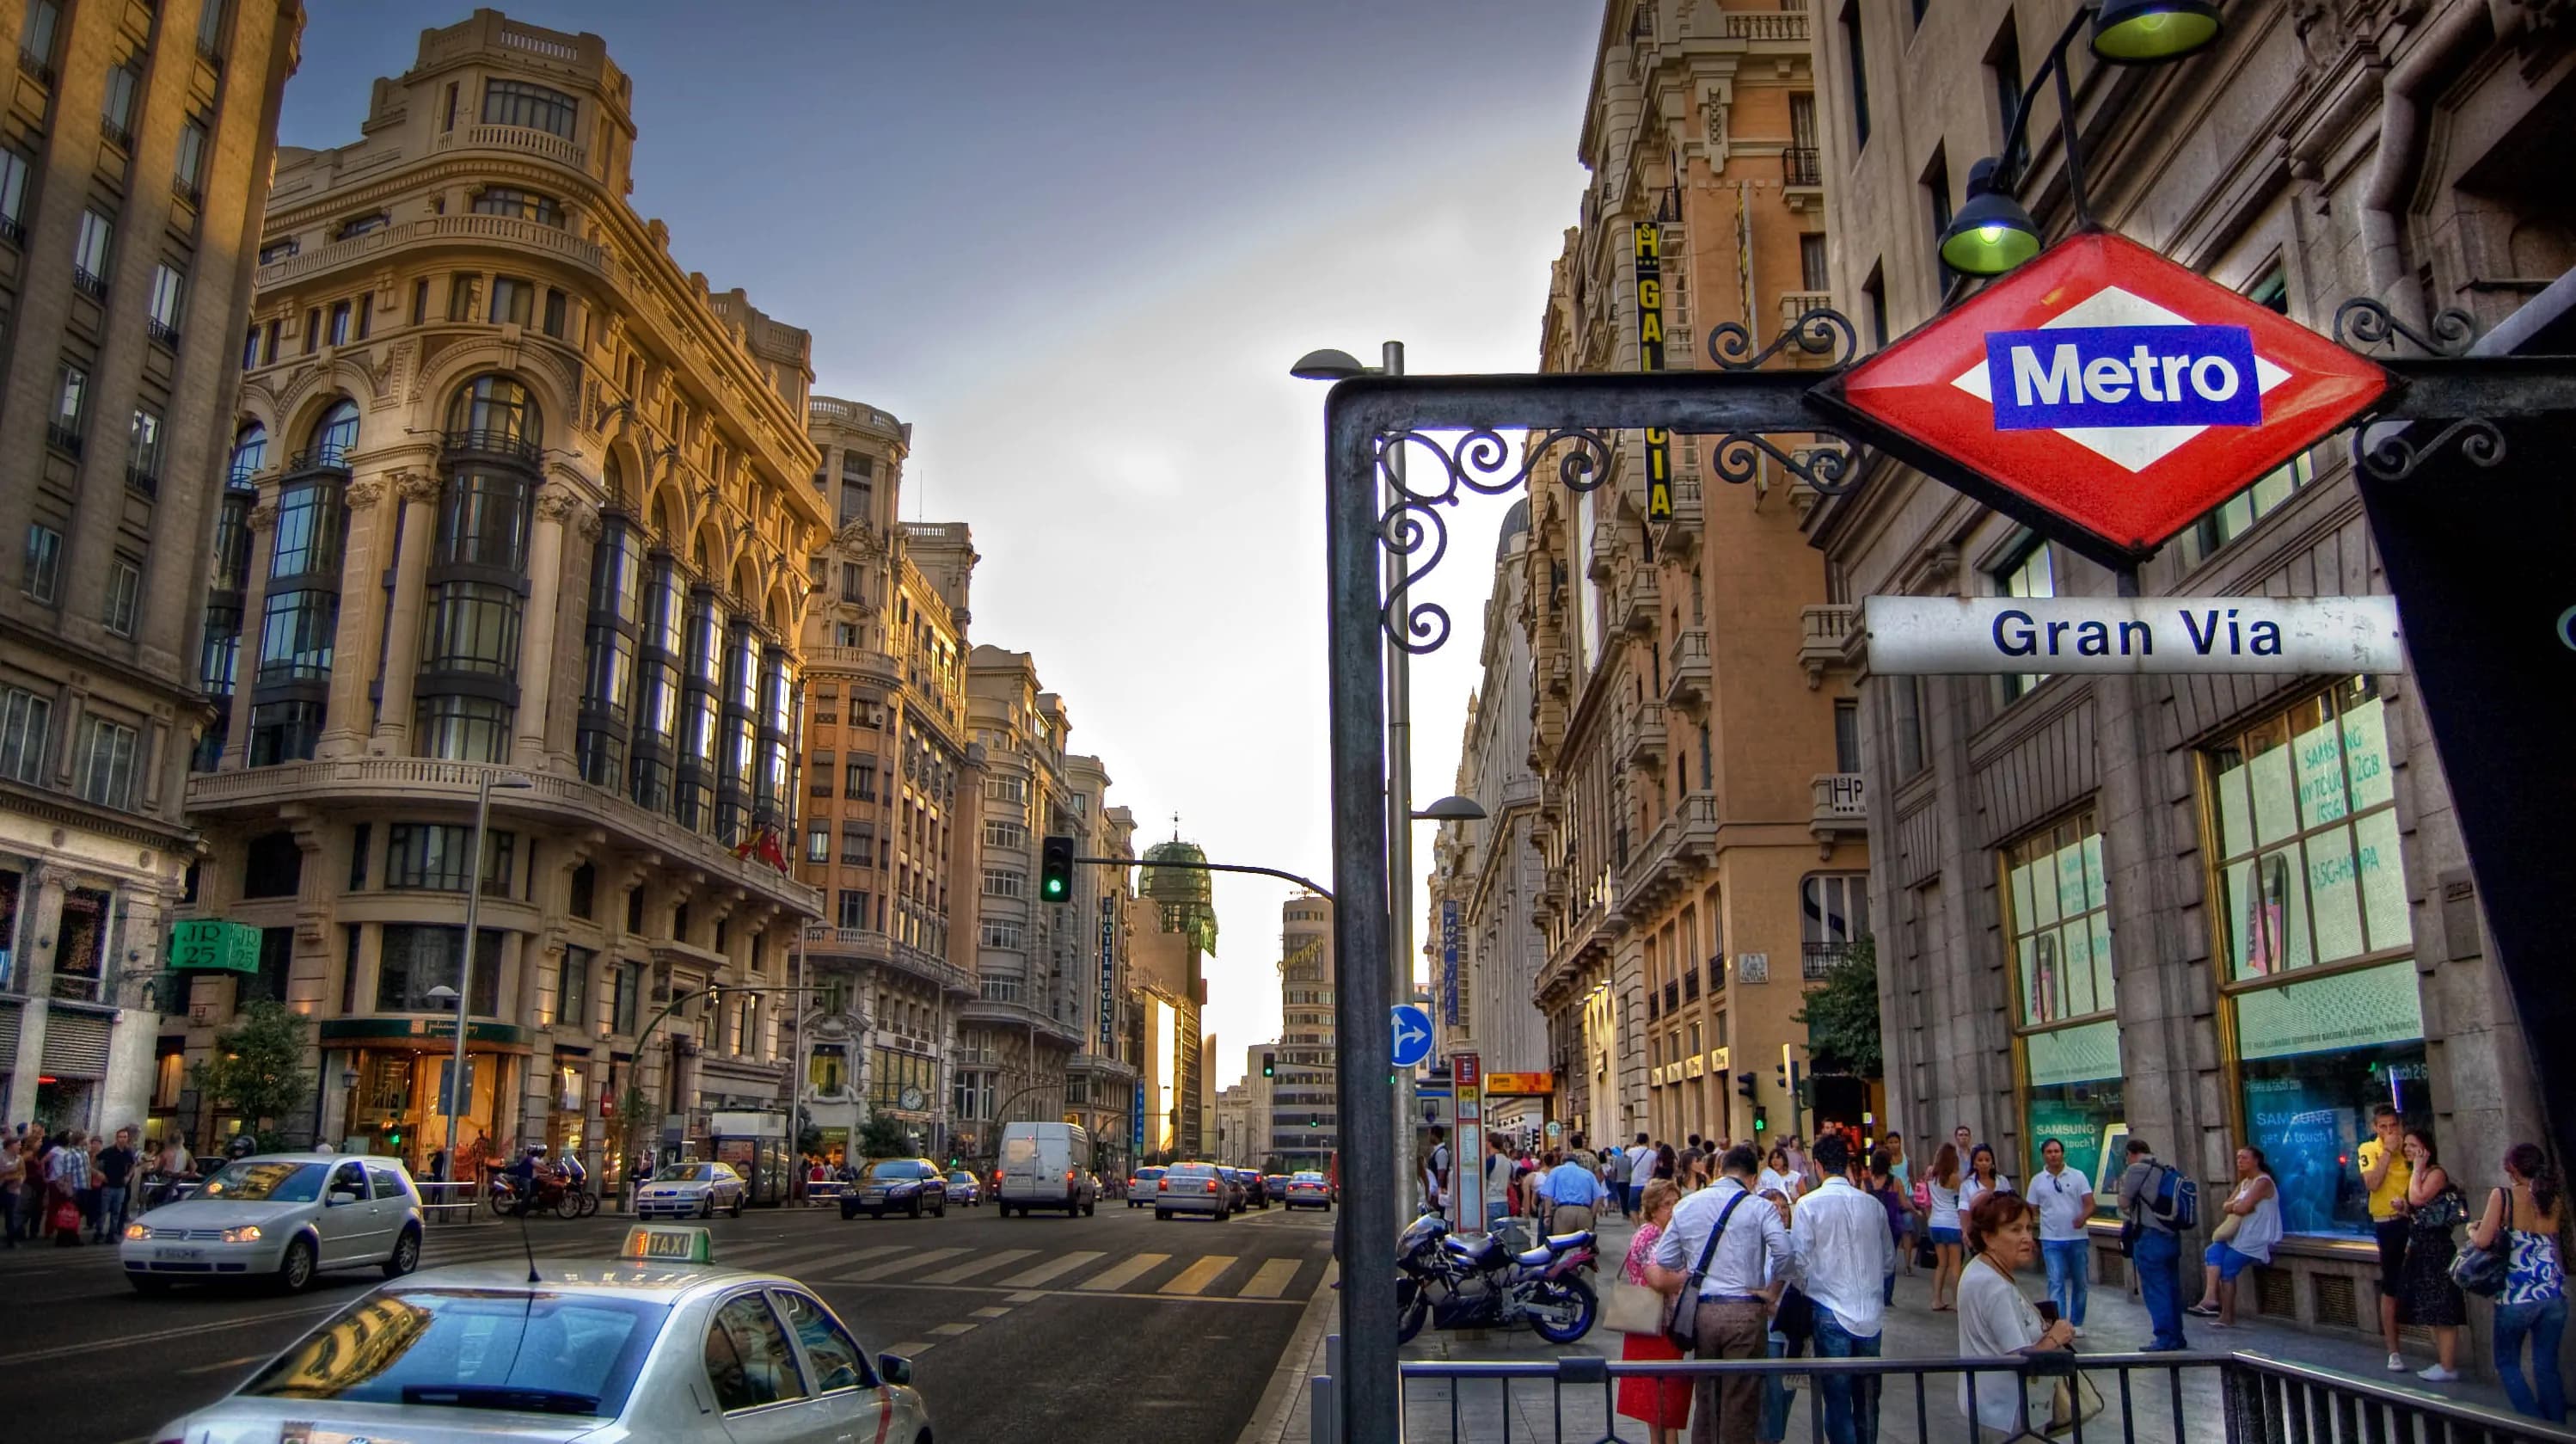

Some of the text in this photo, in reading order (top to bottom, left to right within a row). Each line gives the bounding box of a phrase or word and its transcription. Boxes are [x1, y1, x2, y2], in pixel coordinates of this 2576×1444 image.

[2011, 343, 2239, 408] Metro
[1638, 280, 1671, 516] GALCIA
[1992, 608, 2284, 657] Gran Vía
[2304, 725, 2363, 770] SAMSNG
[182, 925, 221, 943] JR
[237, 928, 258, 947] JR
[1444, 917, 1457, 951] TRYP
[183, 946, 216, 964] 25
[236, 949, 254, 968] 25
[1102, 914, 1113, 1042] HOTEL REGENTE
[2036, 1124, 2095, 1134] SAMSUNG
[2256, 1111, 2333, 1126] SAMSUNG
[652, 1235, 690, 1256] TAXI
